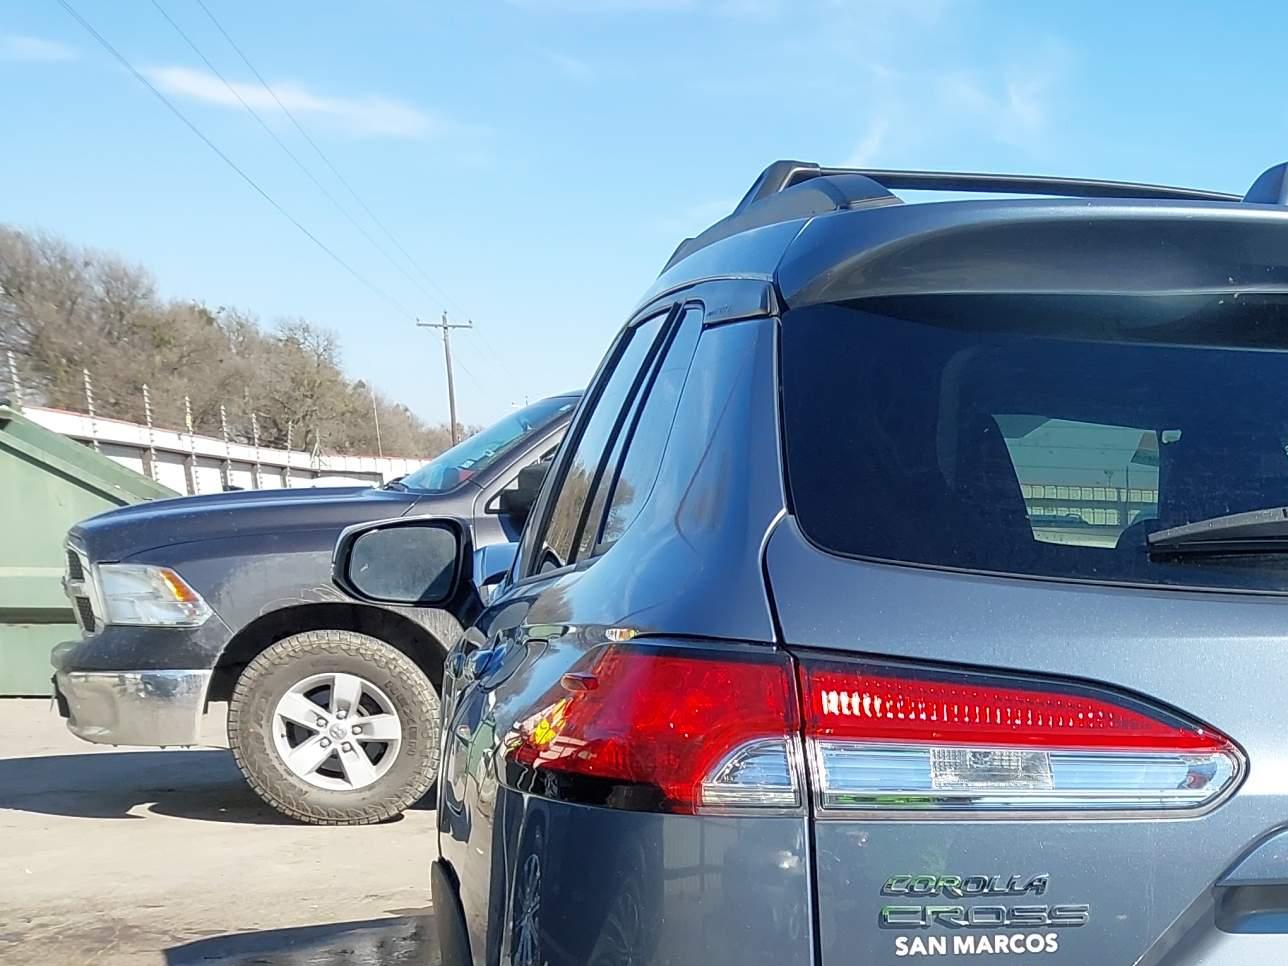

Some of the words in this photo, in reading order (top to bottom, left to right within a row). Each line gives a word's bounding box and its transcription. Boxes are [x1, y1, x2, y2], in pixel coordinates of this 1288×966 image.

[881, 873, 1050, 897] COROLLA
[879, 904, 1090, 928] CROSS
[895, 936, 947, 957] SAN
[954, 933, 1058, 955] MARCOS
